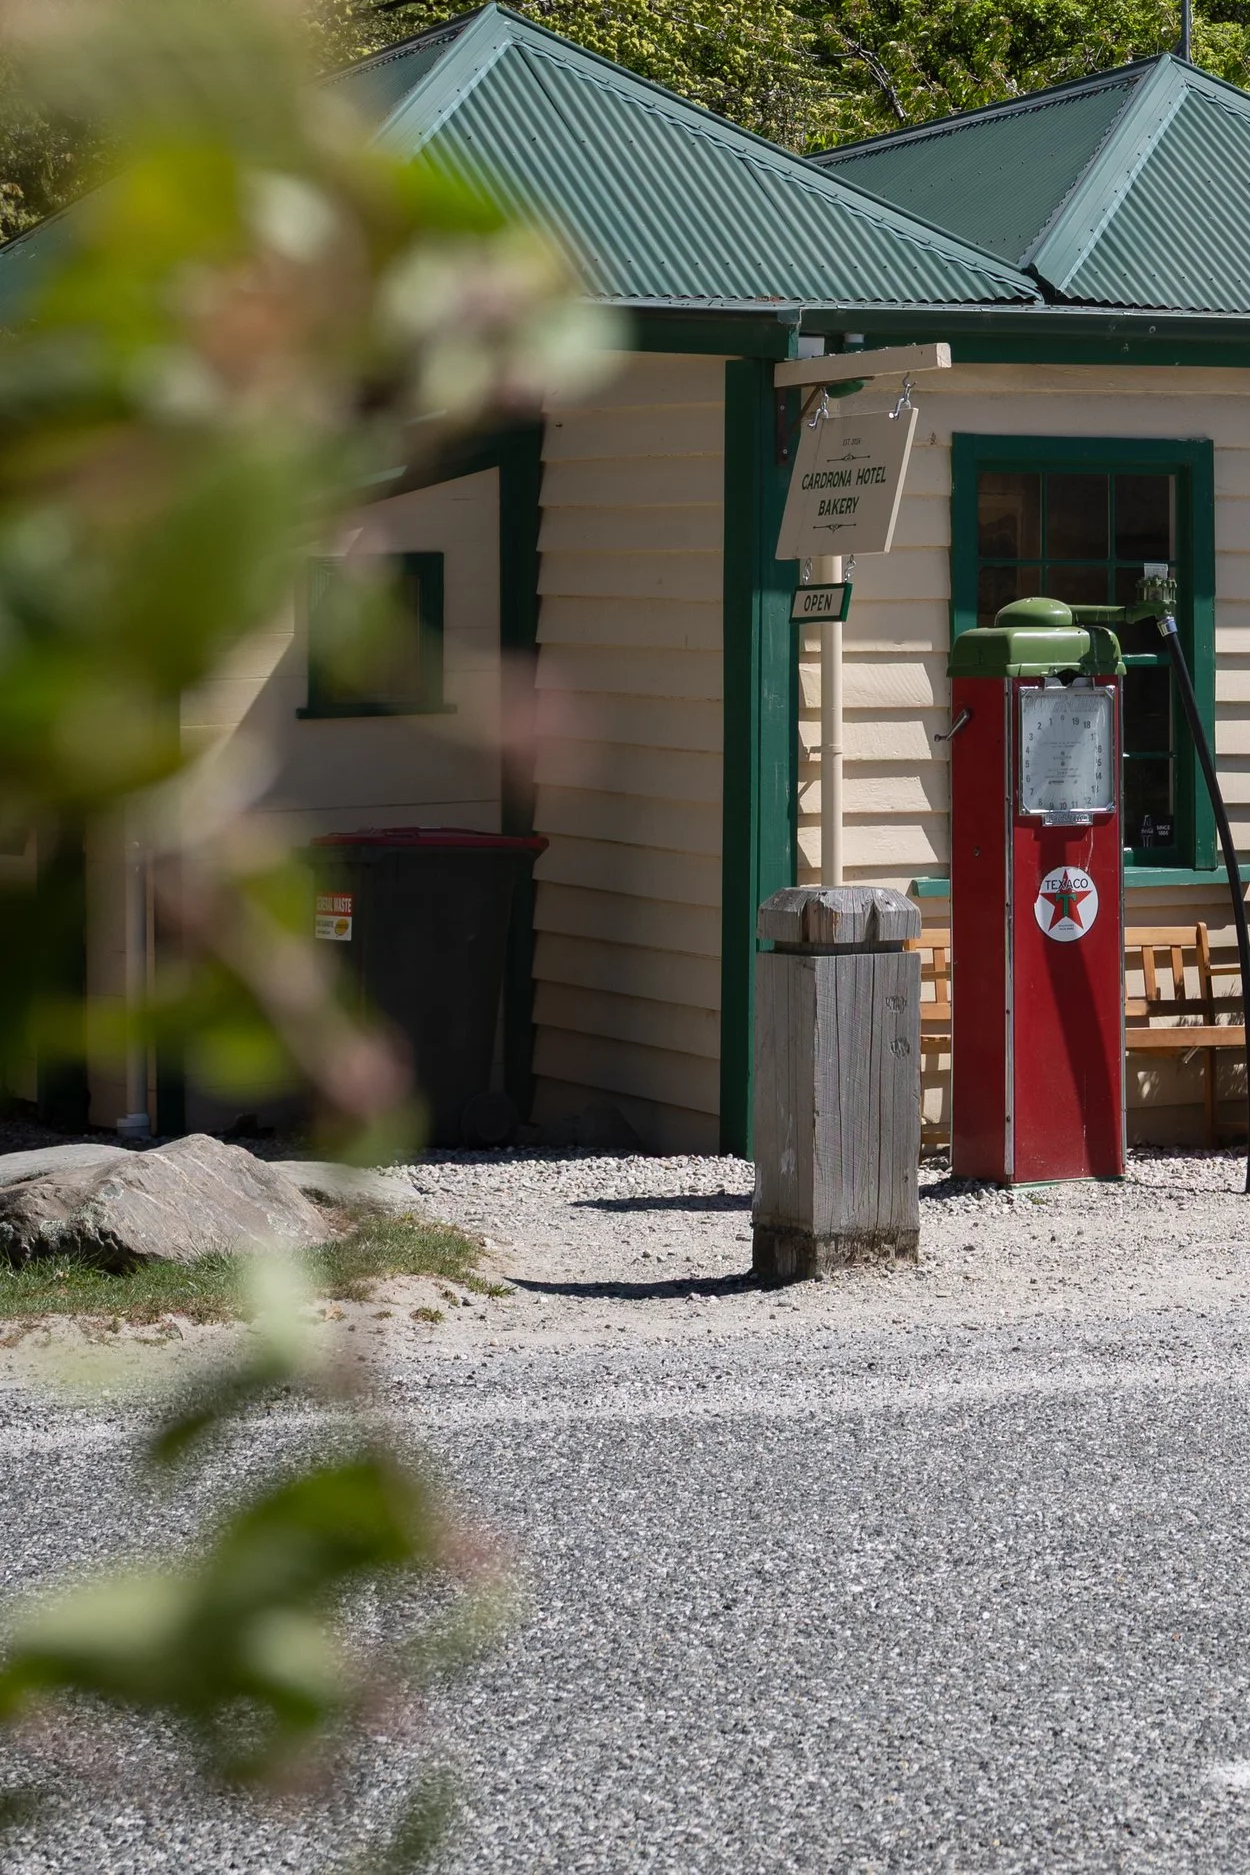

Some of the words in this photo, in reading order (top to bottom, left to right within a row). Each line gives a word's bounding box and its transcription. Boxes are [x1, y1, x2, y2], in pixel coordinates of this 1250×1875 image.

[802, 470, 852, 490] CARDRONA
[856, 466, 886, 485] HOTEL
[818, 497, 860, 516] BAKERY
[804, 594, 832, 612] OPEN
[1045, 878, 1089, 891] TEXACO
[334, 897, 352, 913] WASTE
[1055, 893, 1077, 917] T
